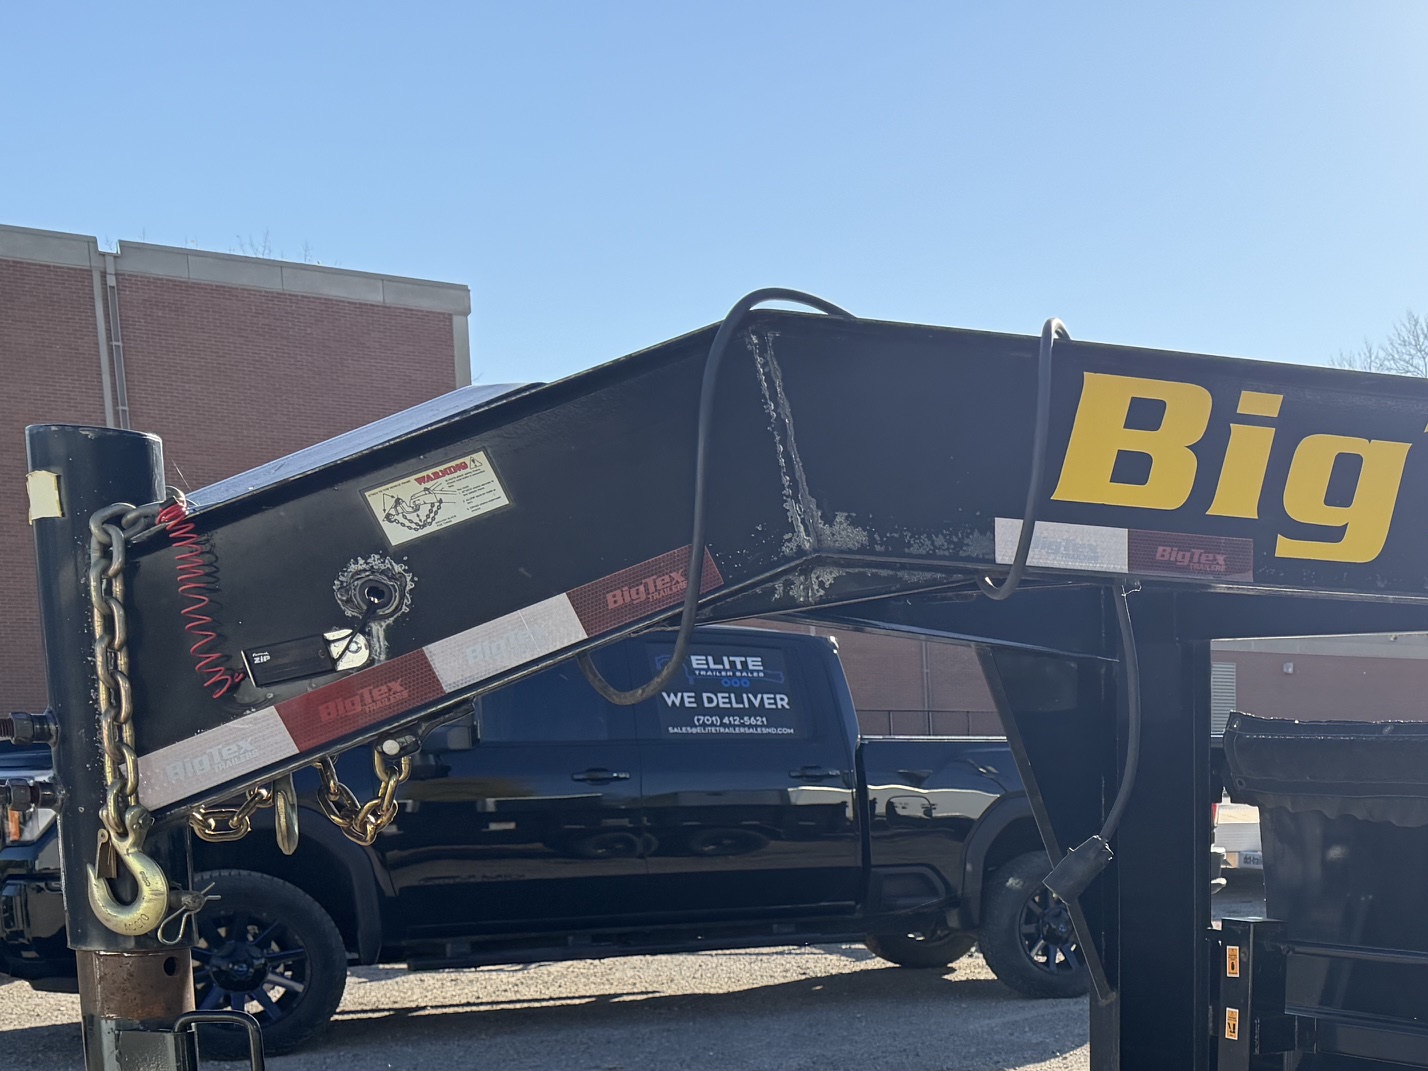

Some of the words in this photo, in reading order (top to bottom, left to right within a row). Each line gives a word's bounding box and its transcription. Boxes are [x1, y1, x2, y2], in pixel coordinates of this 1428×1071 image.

[414, 462, 468, 486] WARNING
[690, 655, 764, 670] ELITE
[662, 692, 697, 707] WE
[702, 692, 790, 709] DELIVER
[694, 715, 720, 726] (701)
[722, 716, 767, 725] 412-5621
